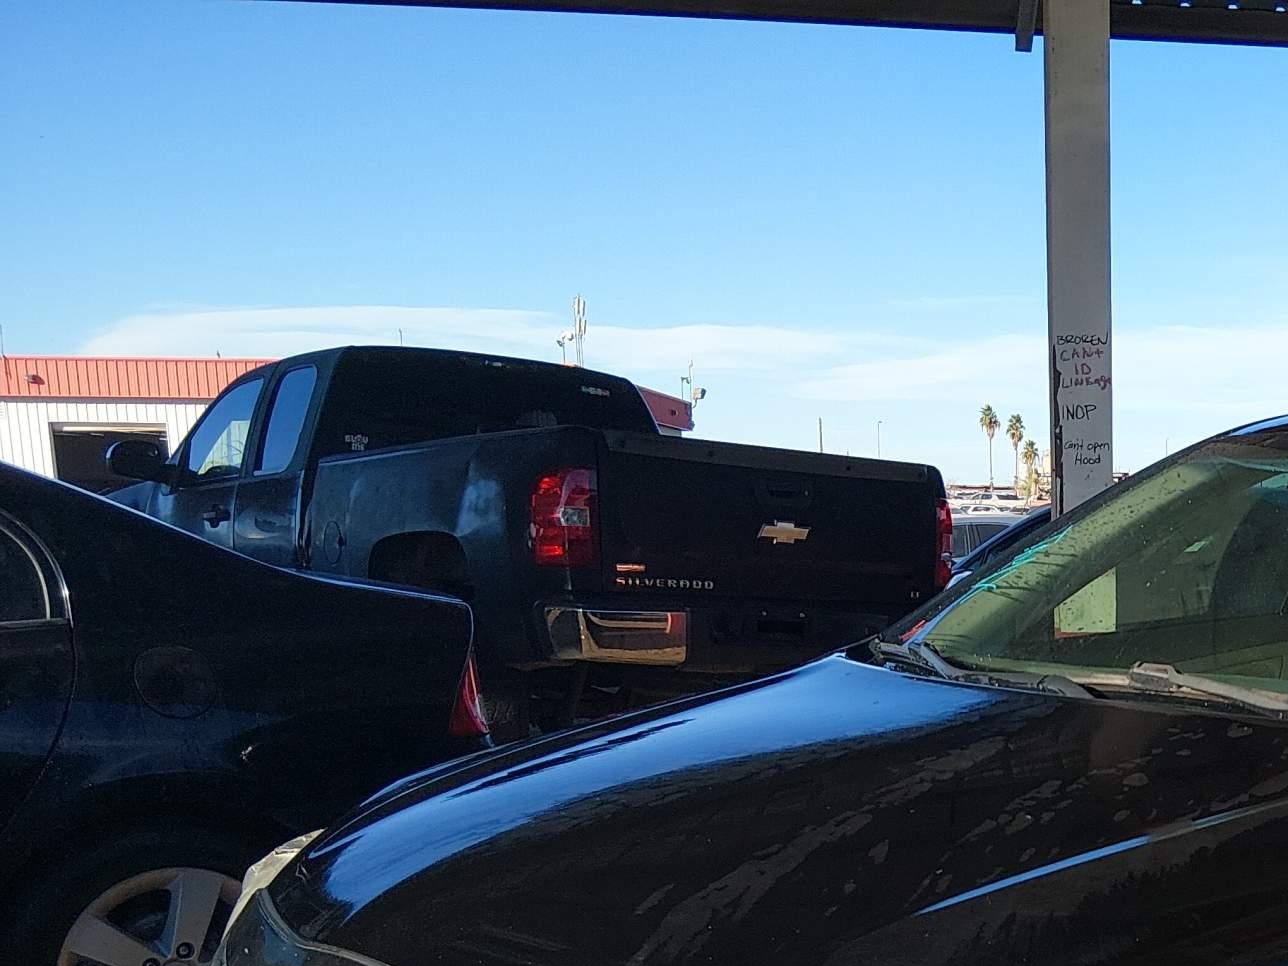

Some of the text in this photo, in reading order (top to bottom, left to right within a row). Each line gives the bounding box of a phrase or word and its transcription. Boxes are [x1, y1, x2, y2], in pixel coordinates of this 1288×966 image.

[1062, 404, 1097, 420] INOP
[1074, 452, 1101, 466] Hood
[615, 577, 715, 590] SILVERADO
